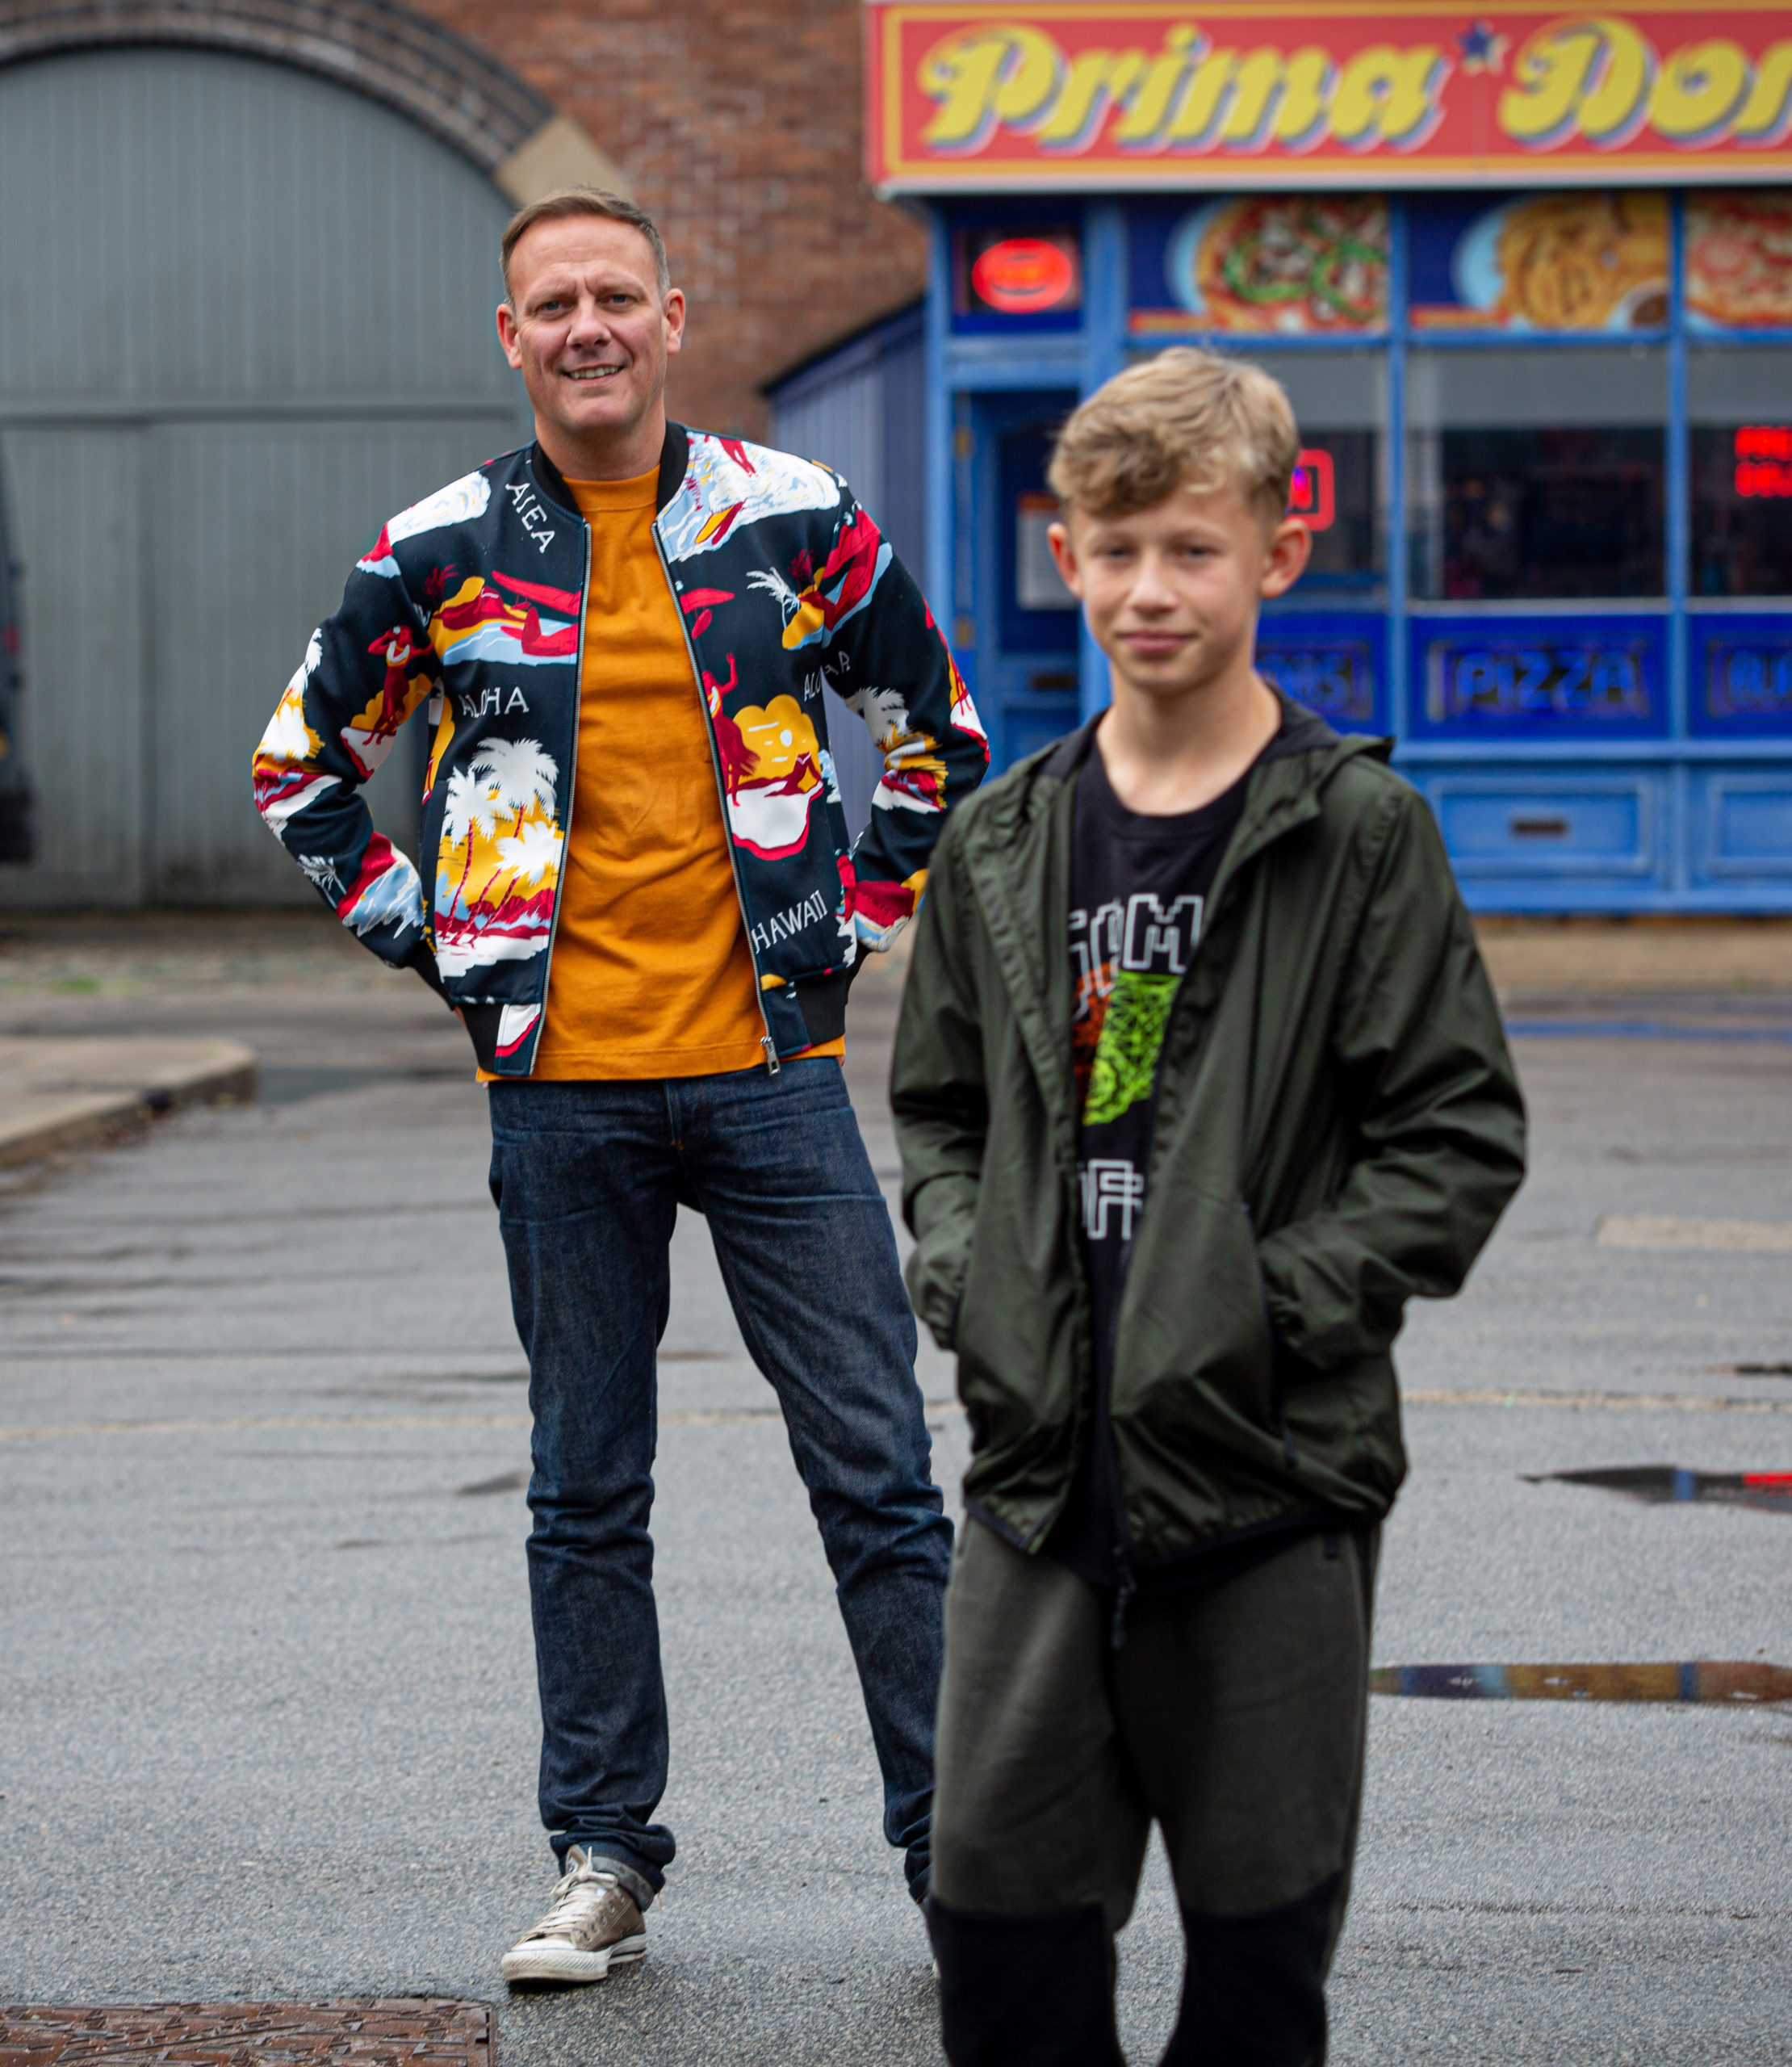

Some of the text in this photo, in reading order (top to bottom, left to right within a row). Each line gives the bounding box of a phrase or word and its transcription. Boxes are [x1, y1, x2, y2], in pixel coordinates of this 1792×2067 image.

[918, 22, 1453, 156] Prima
[505, 482, 555, 554] AIEA
[458, 686, 530, 718] ALOHA
[1455, 649, 1638, 710] PIZZA
[750, 890, 829, 954] HAWAII
